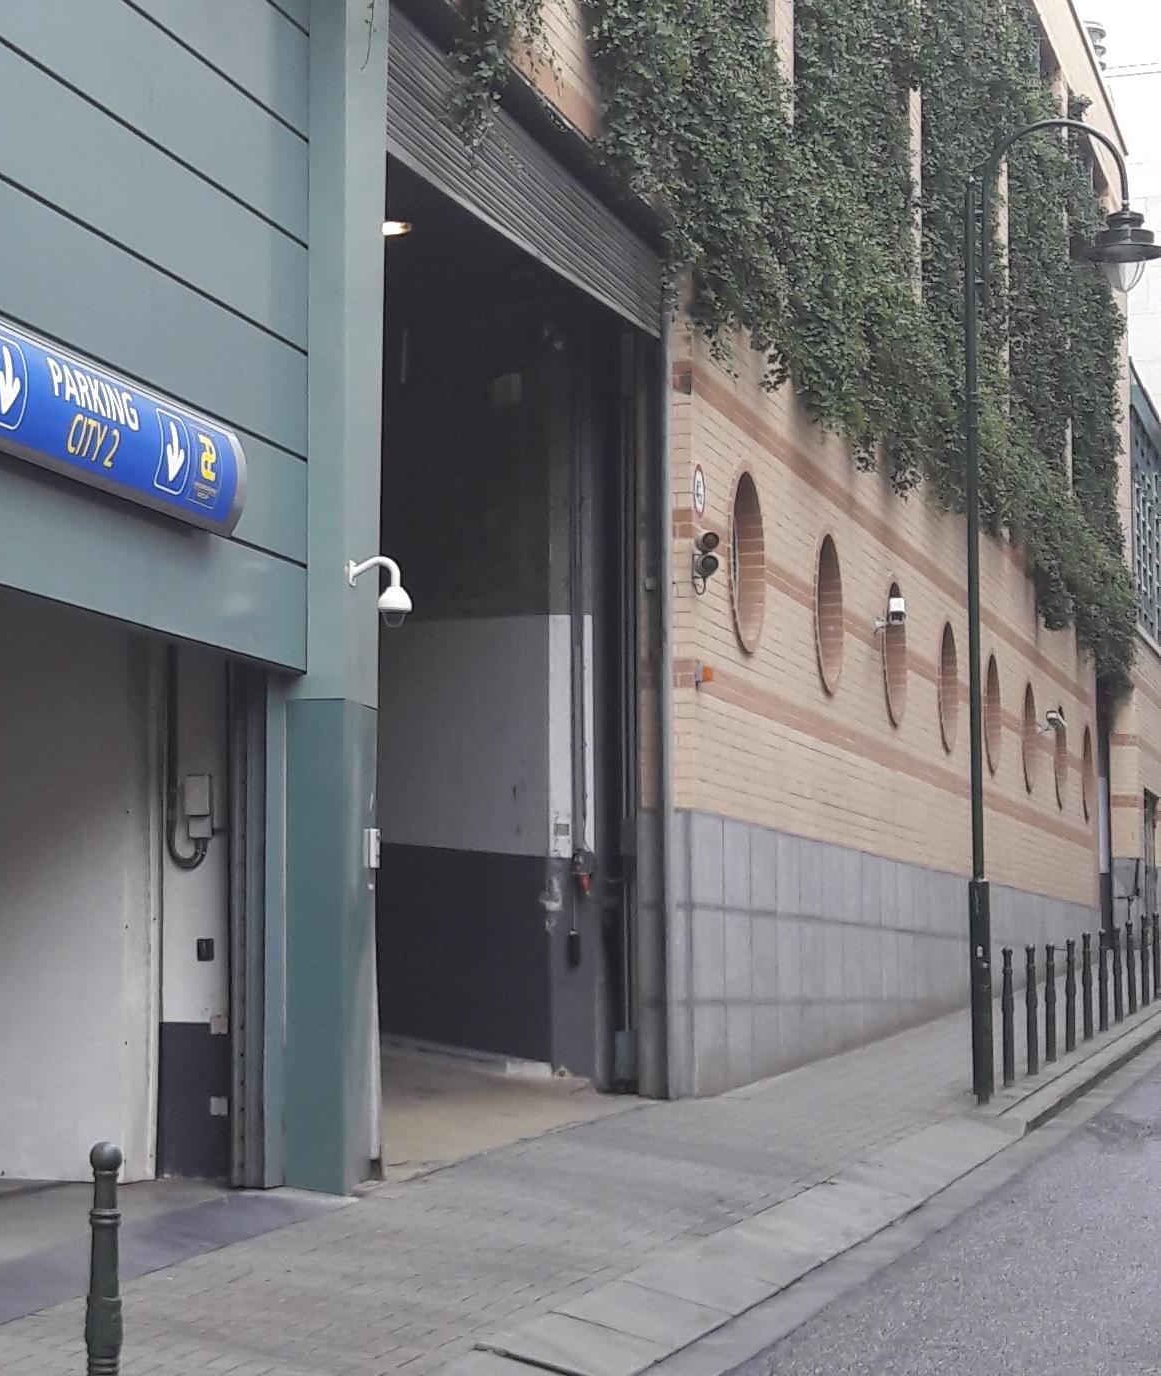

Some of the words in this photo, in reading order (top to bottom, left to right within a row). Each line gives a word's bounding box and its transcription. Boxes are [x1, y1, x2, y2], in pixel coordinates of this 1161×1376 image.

[46, 356, 139, 431] PARKING
[66, 413, 109, 462] CITY
[102, 428, 121, 469] 2
